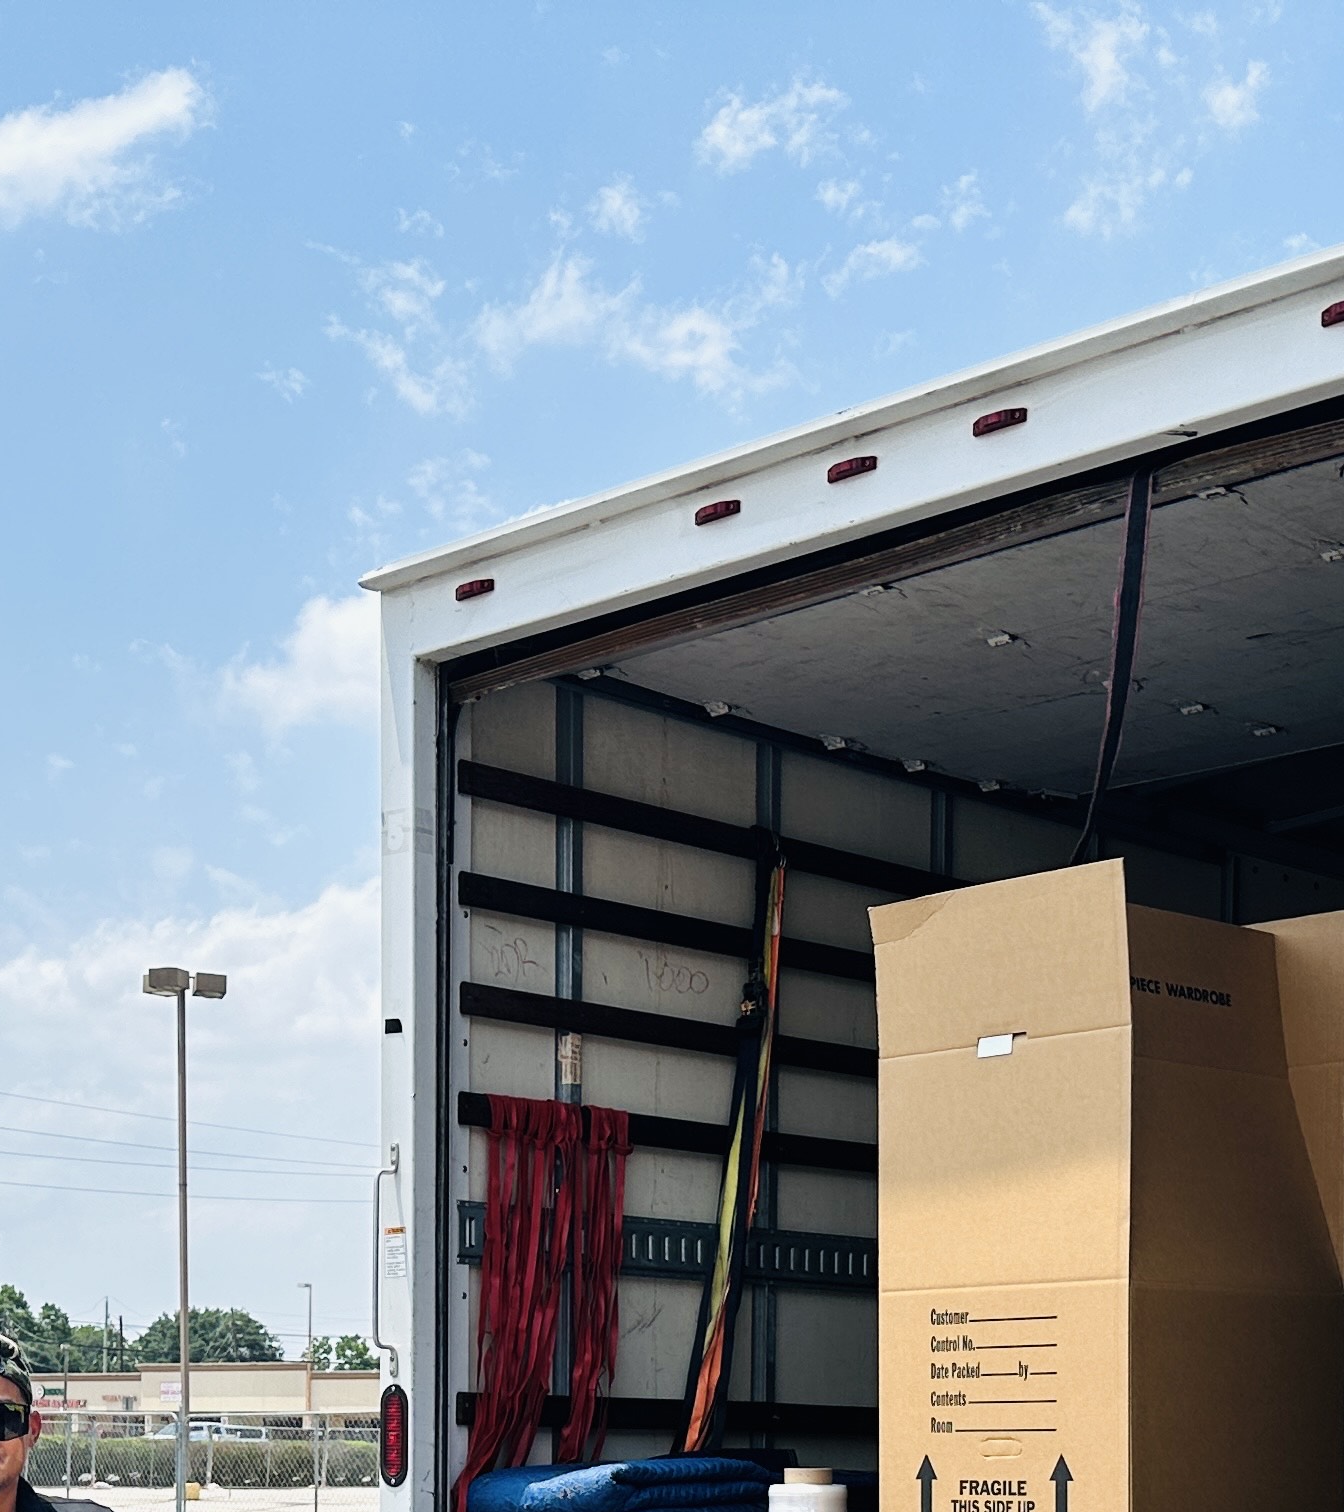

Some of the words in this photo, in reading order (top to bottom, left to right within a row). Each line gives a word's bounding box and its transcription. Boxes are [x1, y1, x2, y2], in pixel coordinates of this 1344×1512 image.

[1165, 982, 1233, 1007] WARDROBE
[930, 1308, 969, 1326] Customer
[930, 1335, 960, 1352] Control
[962, 1335, 976, 1351] No.
[930, 1362, 950, 1379] Date
[951, 1361, 981, 1379] Packed
[1018, 1361, 1029, 1381] by
[930, 1391, 967, 1407] Contents
[930, 1417, 953, 1433] Room
[959, 1480, 1027, 1496] FRAGILE
